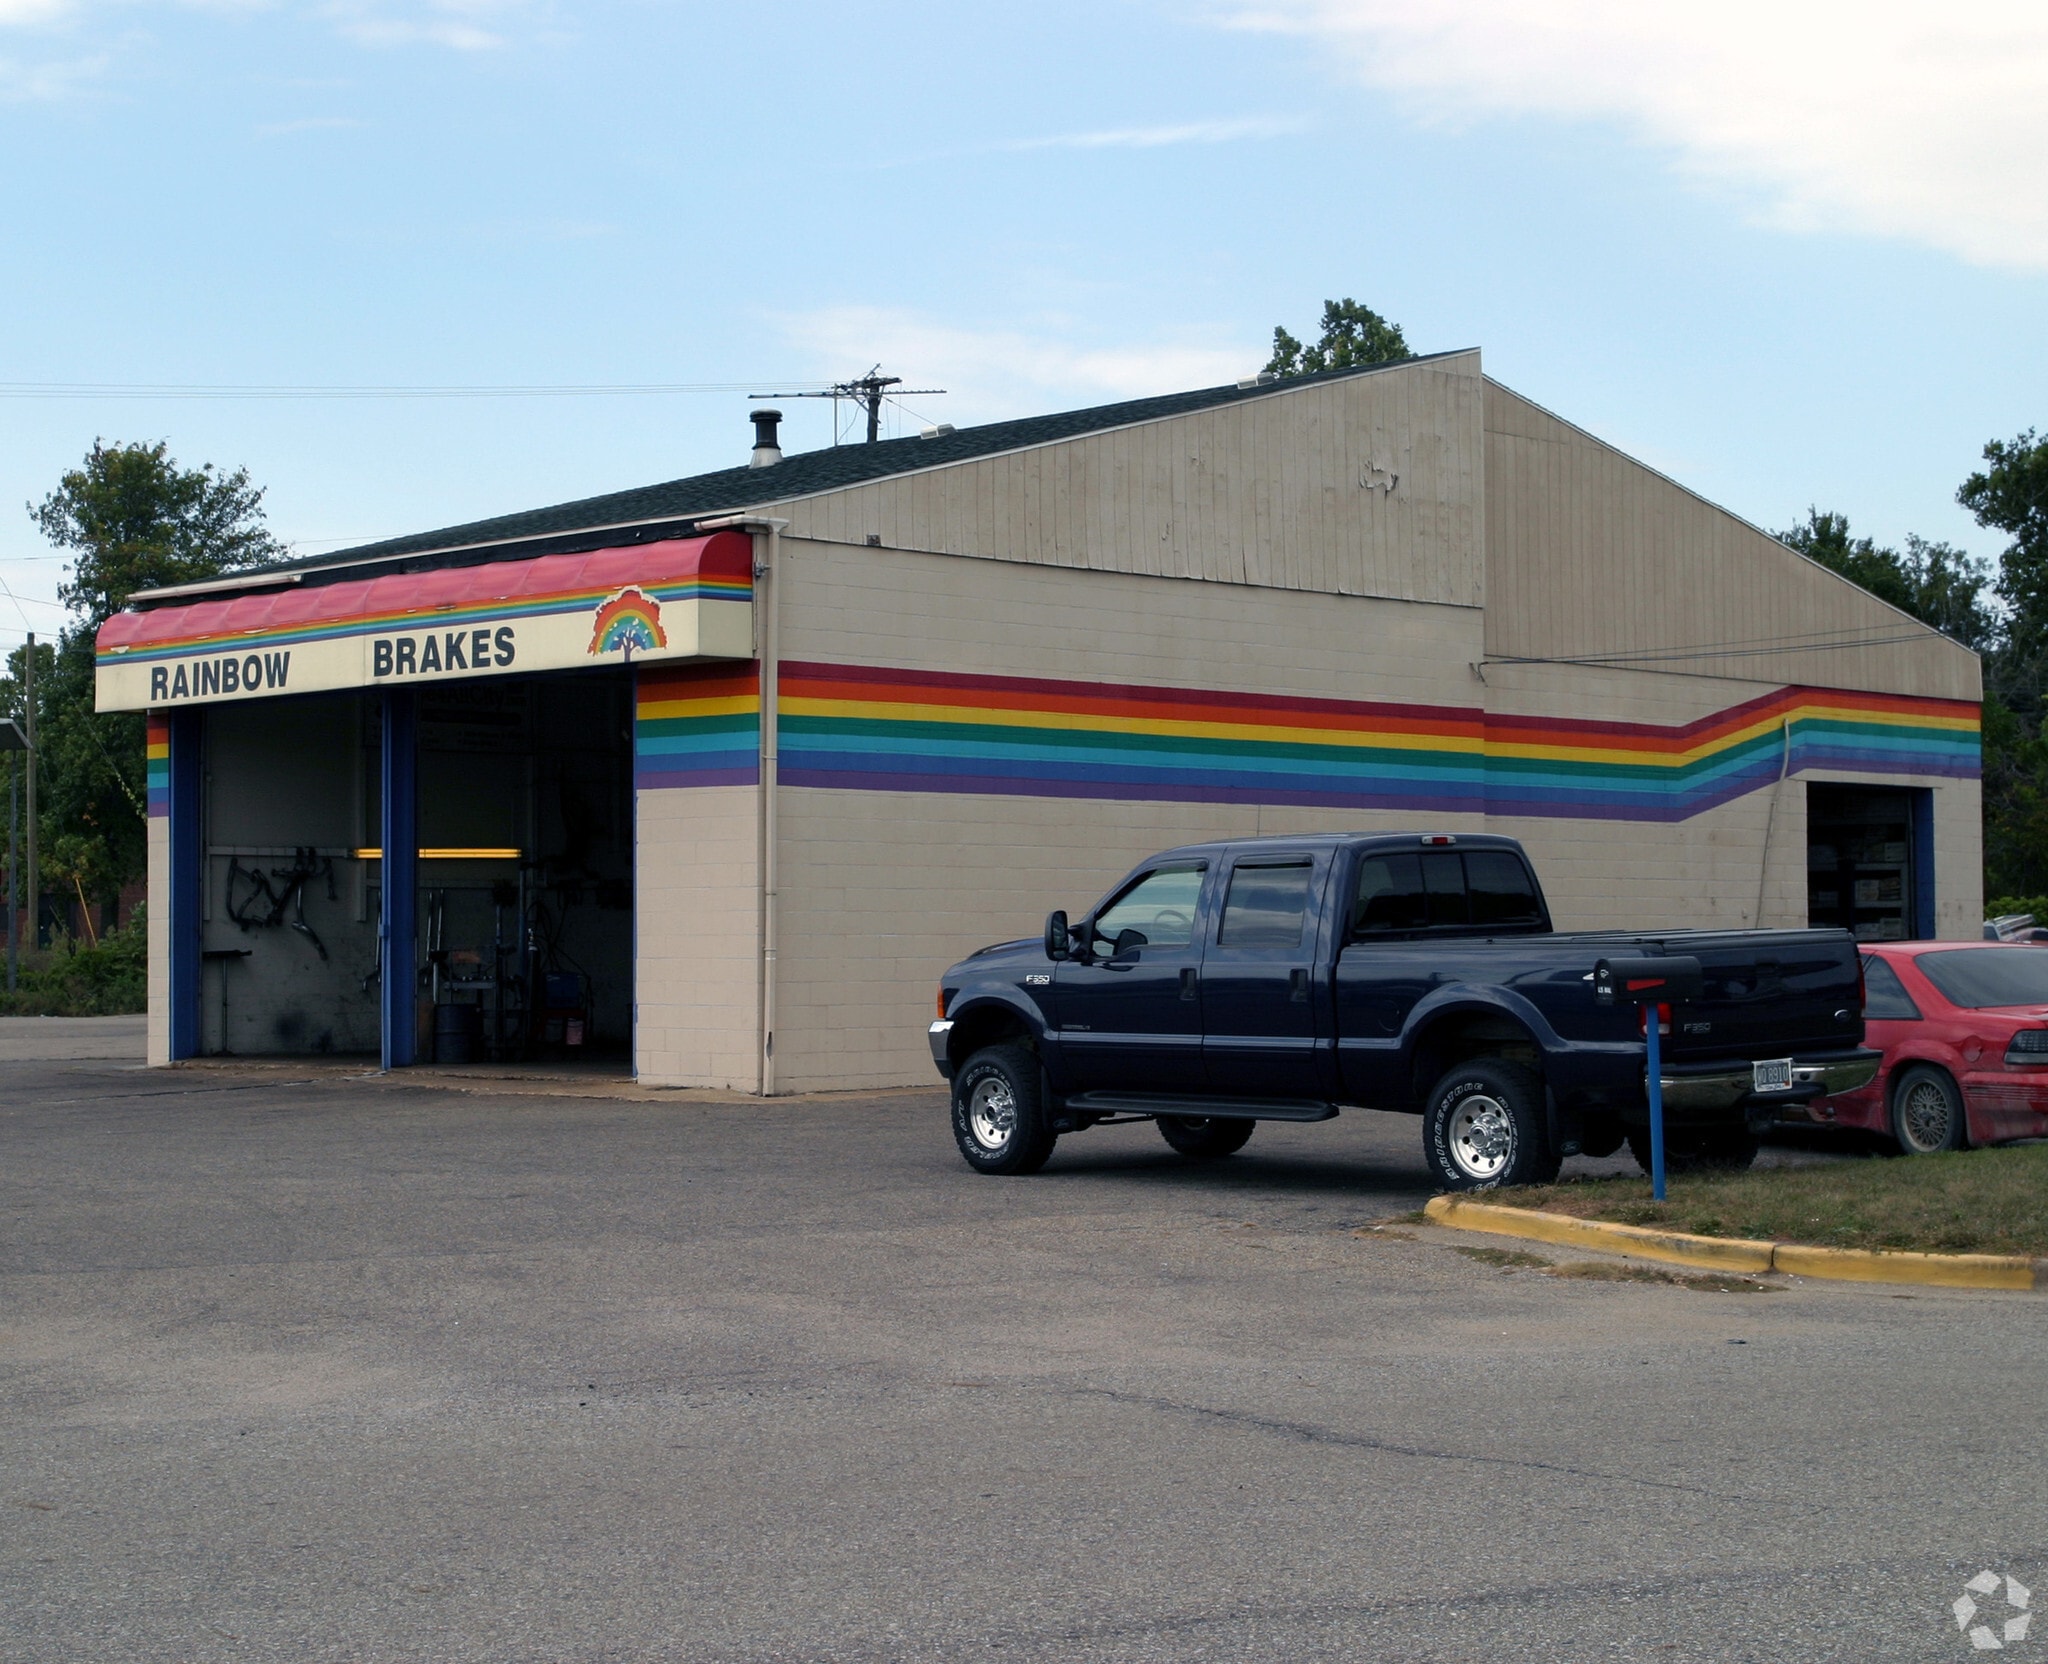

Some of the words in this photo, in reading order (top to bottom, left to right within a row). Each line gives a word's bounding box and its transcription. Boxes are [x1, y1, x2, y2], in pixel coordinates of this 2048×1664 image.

[152, 652, 290, 700] RAINBOW
[374, 627, 514, 676] BRAKES
[1684, 1022, 1711, 1033] F350
[1434, 1082, 1484, 1180] BRIDGESTONE
